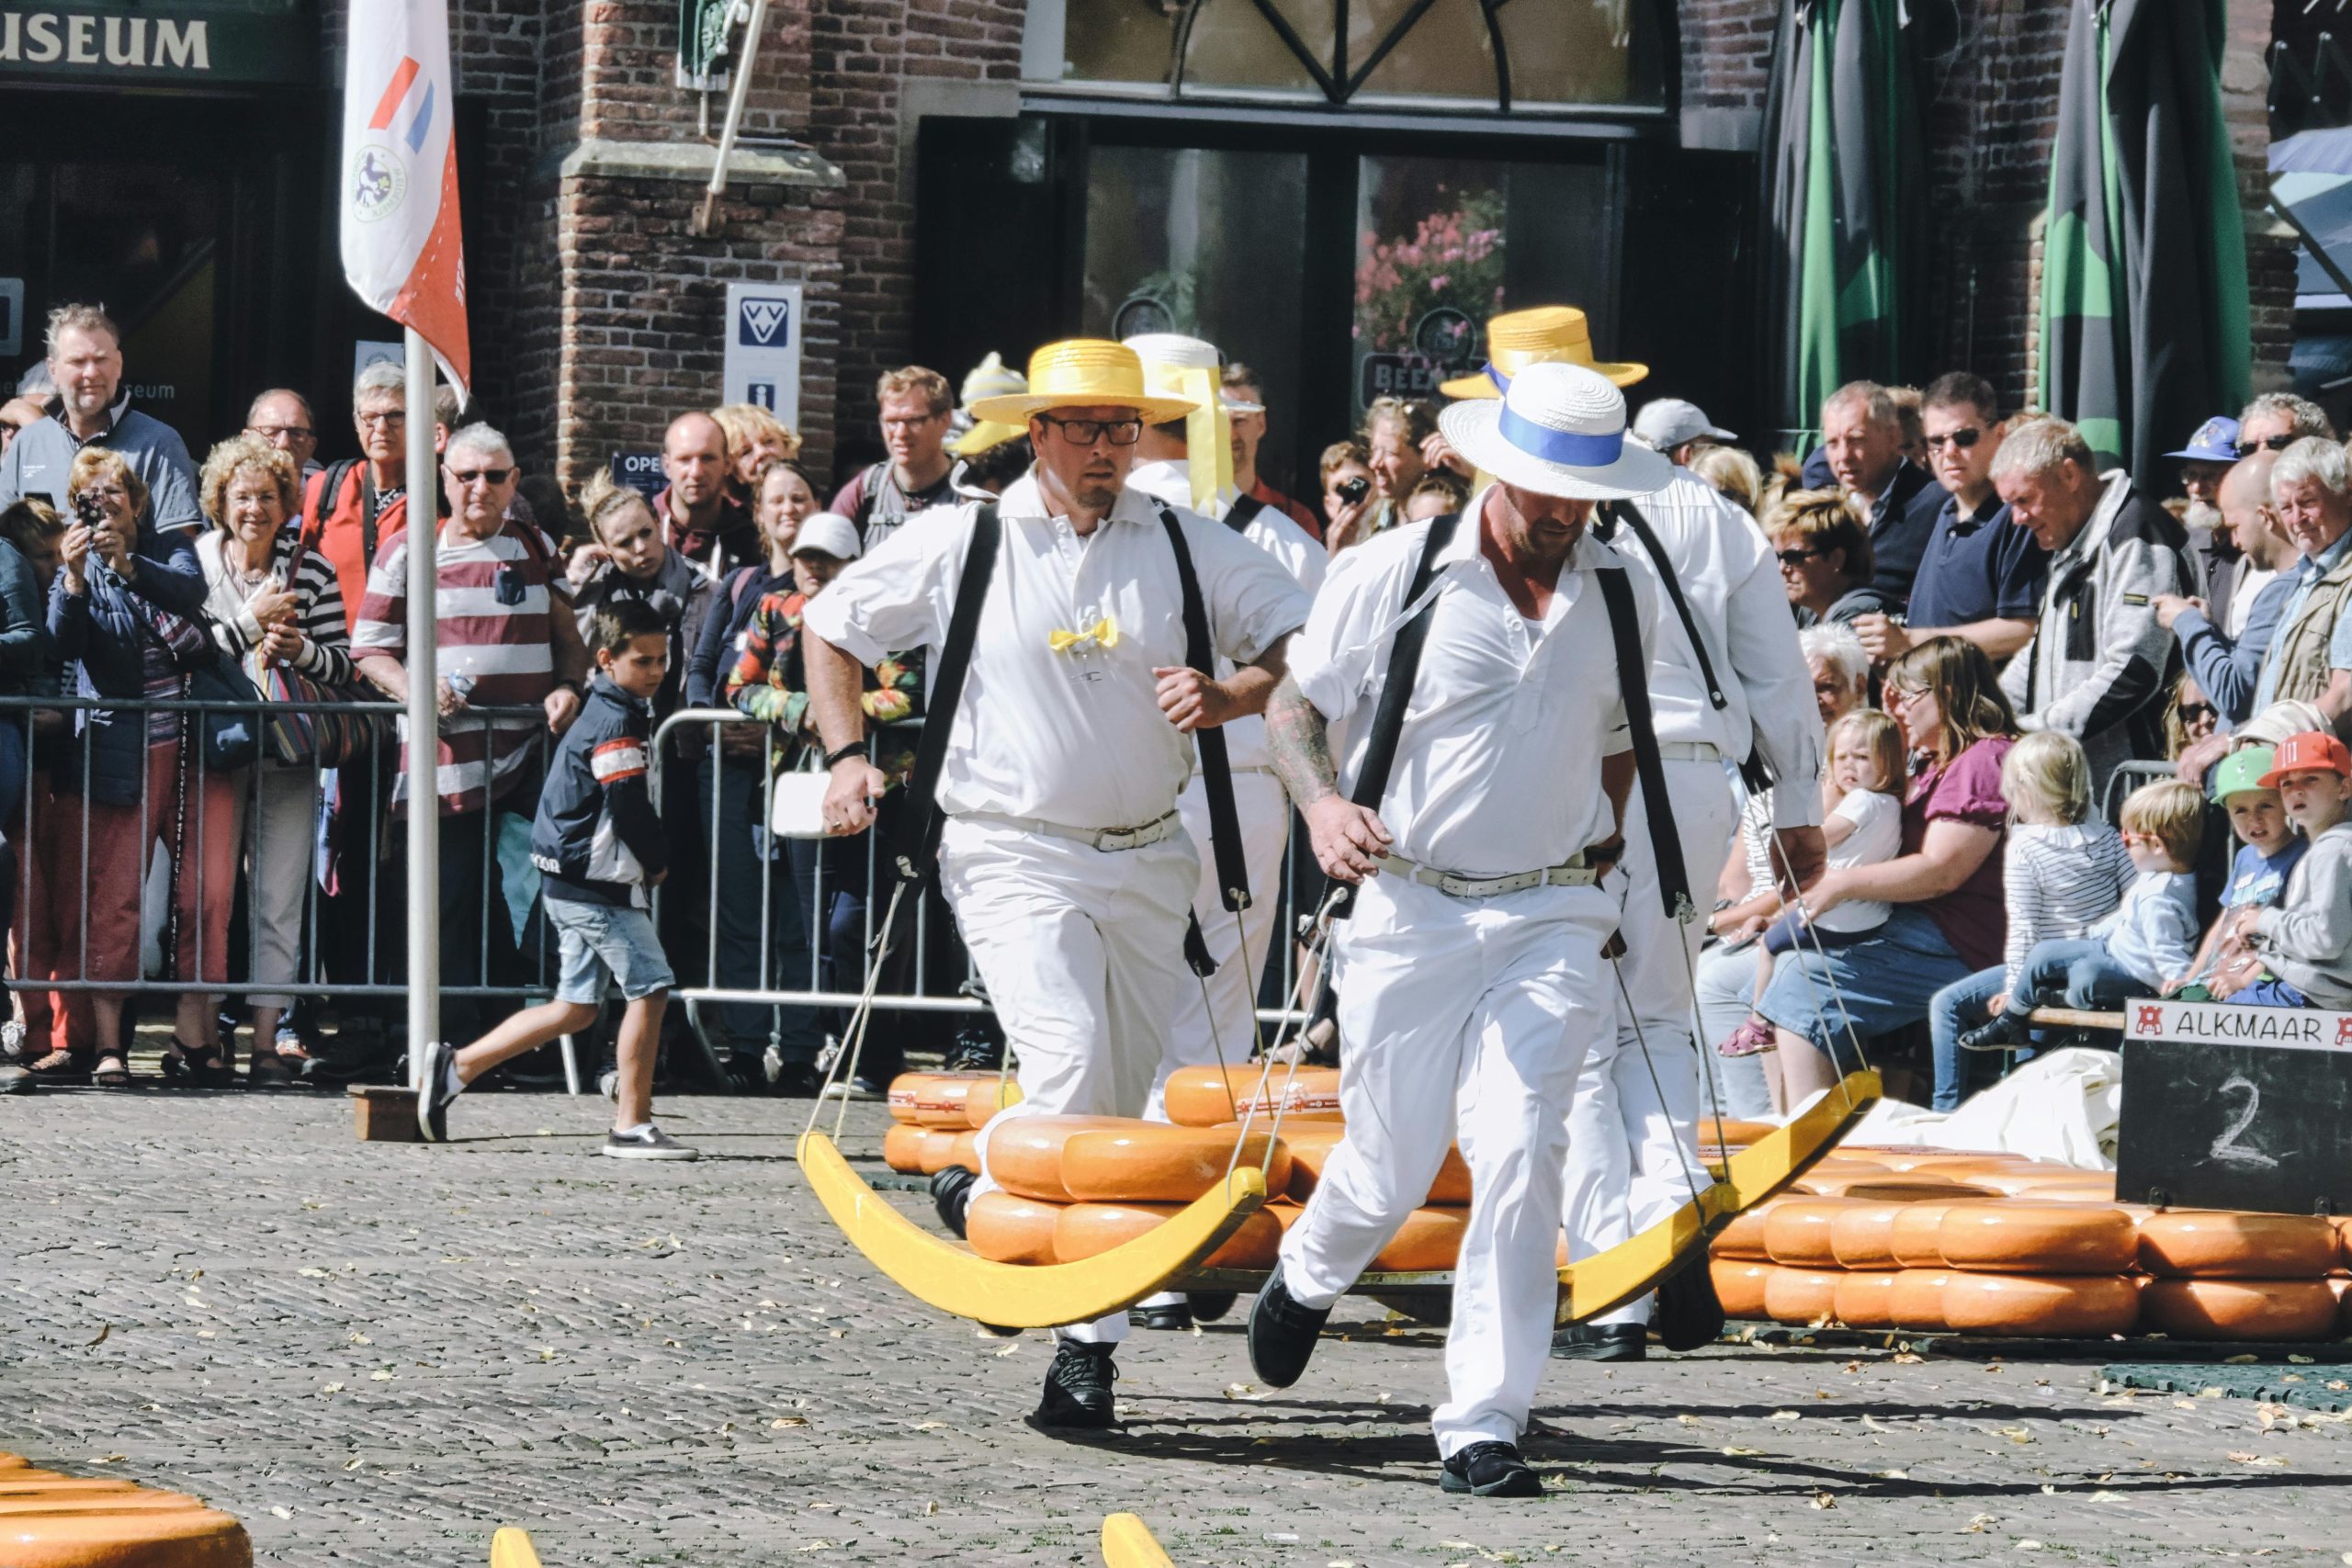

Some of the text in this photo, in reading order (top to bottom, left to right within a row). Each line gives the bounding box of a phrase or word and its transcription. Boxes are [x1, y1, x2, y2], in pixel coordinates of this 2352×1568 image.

[624, 456, 661, 473] OPE
[2175, 1010, 2323, 1043] ALKMAAR
[2209, 1075, 2279, 1168] 2
